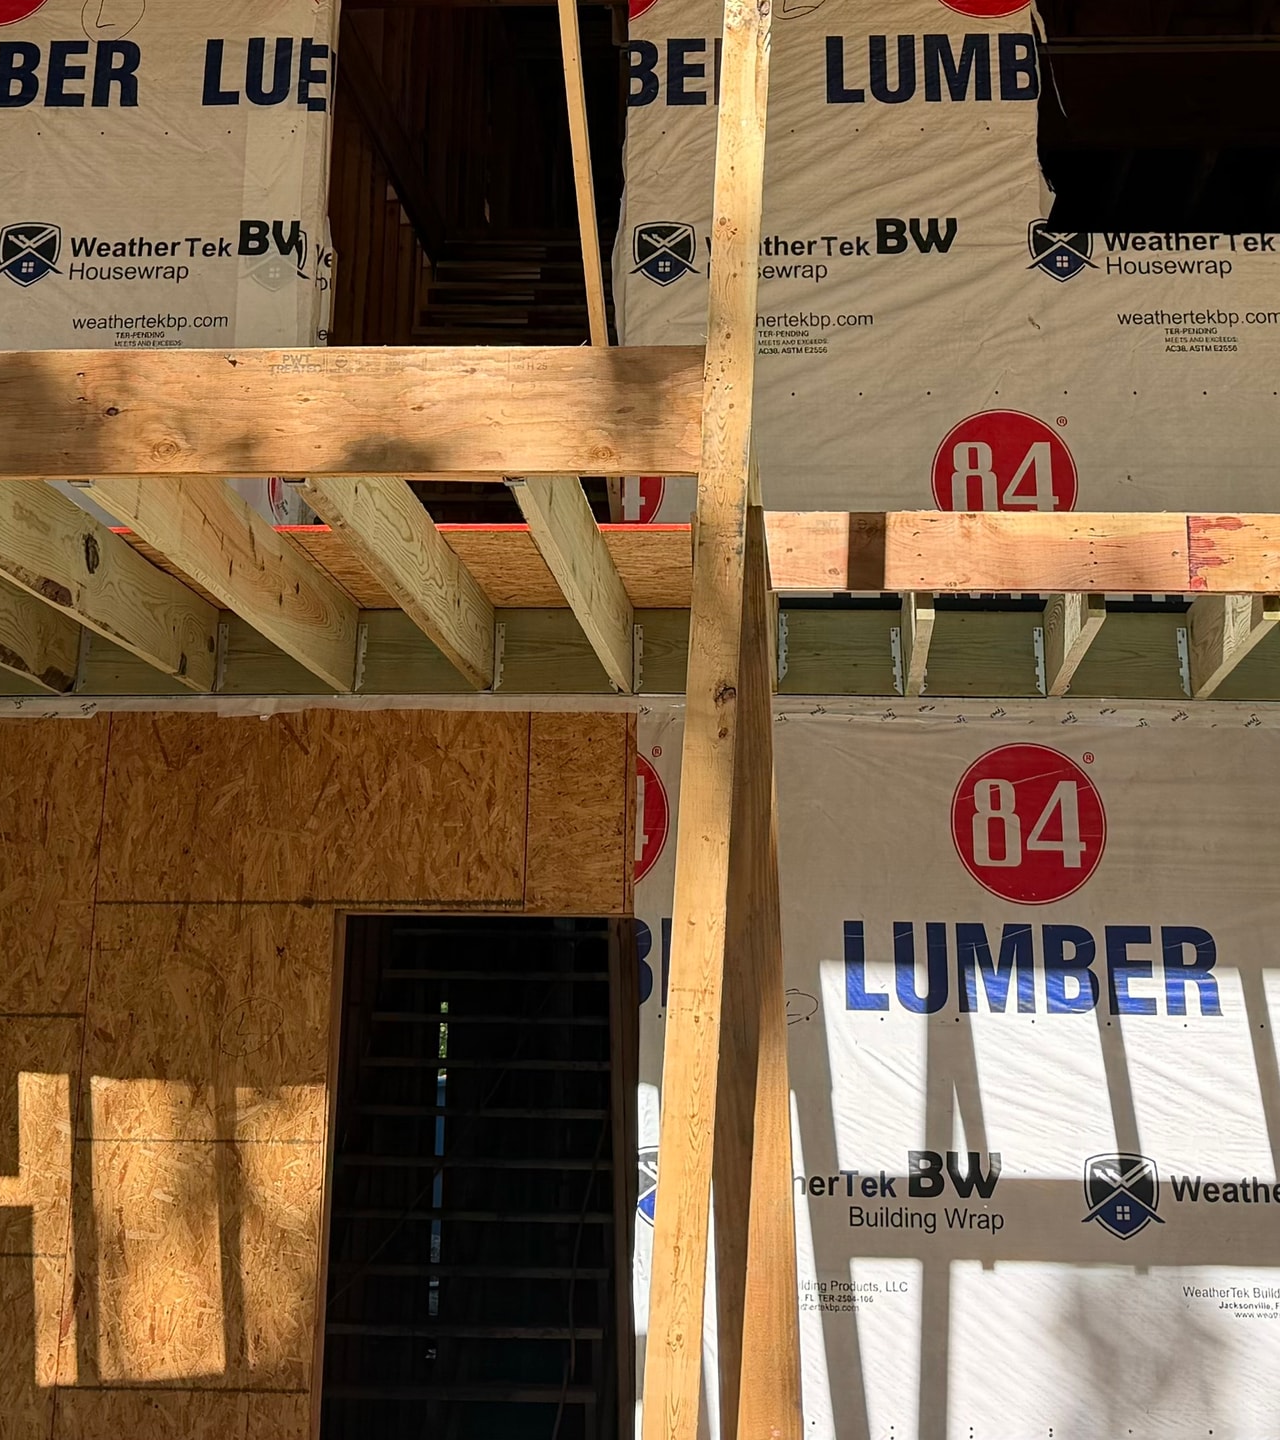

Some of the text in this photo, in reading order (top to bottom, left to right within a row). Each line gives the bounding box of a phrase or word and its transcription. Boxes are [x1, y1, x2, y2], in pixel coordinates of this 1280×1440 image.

[824, 32, 1039, 104] LUMB
[70, 237, 233, 258] Weather Tek
[821, 217, 958, 257] Tek BW
[1104, 232, 1220, 252] Weather
[1221, 232, 1276, 252] Tek
[69, 262, 189, 283] Housewrap
[1106, 256, 1233, 279] Housewrap
[72, 313, 229, 333] weathertekbp.com
[1164, 327, 1218, 335] TER-PENDING
[758, 330, 809, 338] TER-PENDING
[282, 354, 312, 364] PWT
[781, 347, 804, 355] ASTM
[1189, 345, 1213, 353] ASTM
[951, 440, 1057, 512] 84
[972, 778, 1087, 869] 84
[843, 920, 1223, 1017] LUMBER
[907, 1150, 1003, 1199] BW
[849, 1206, 1005, 1236] Building Wrap
[830, 1280, 909, 1294] Products, LLC
[1182, 1285, 1250, 1299] WeatherTek
